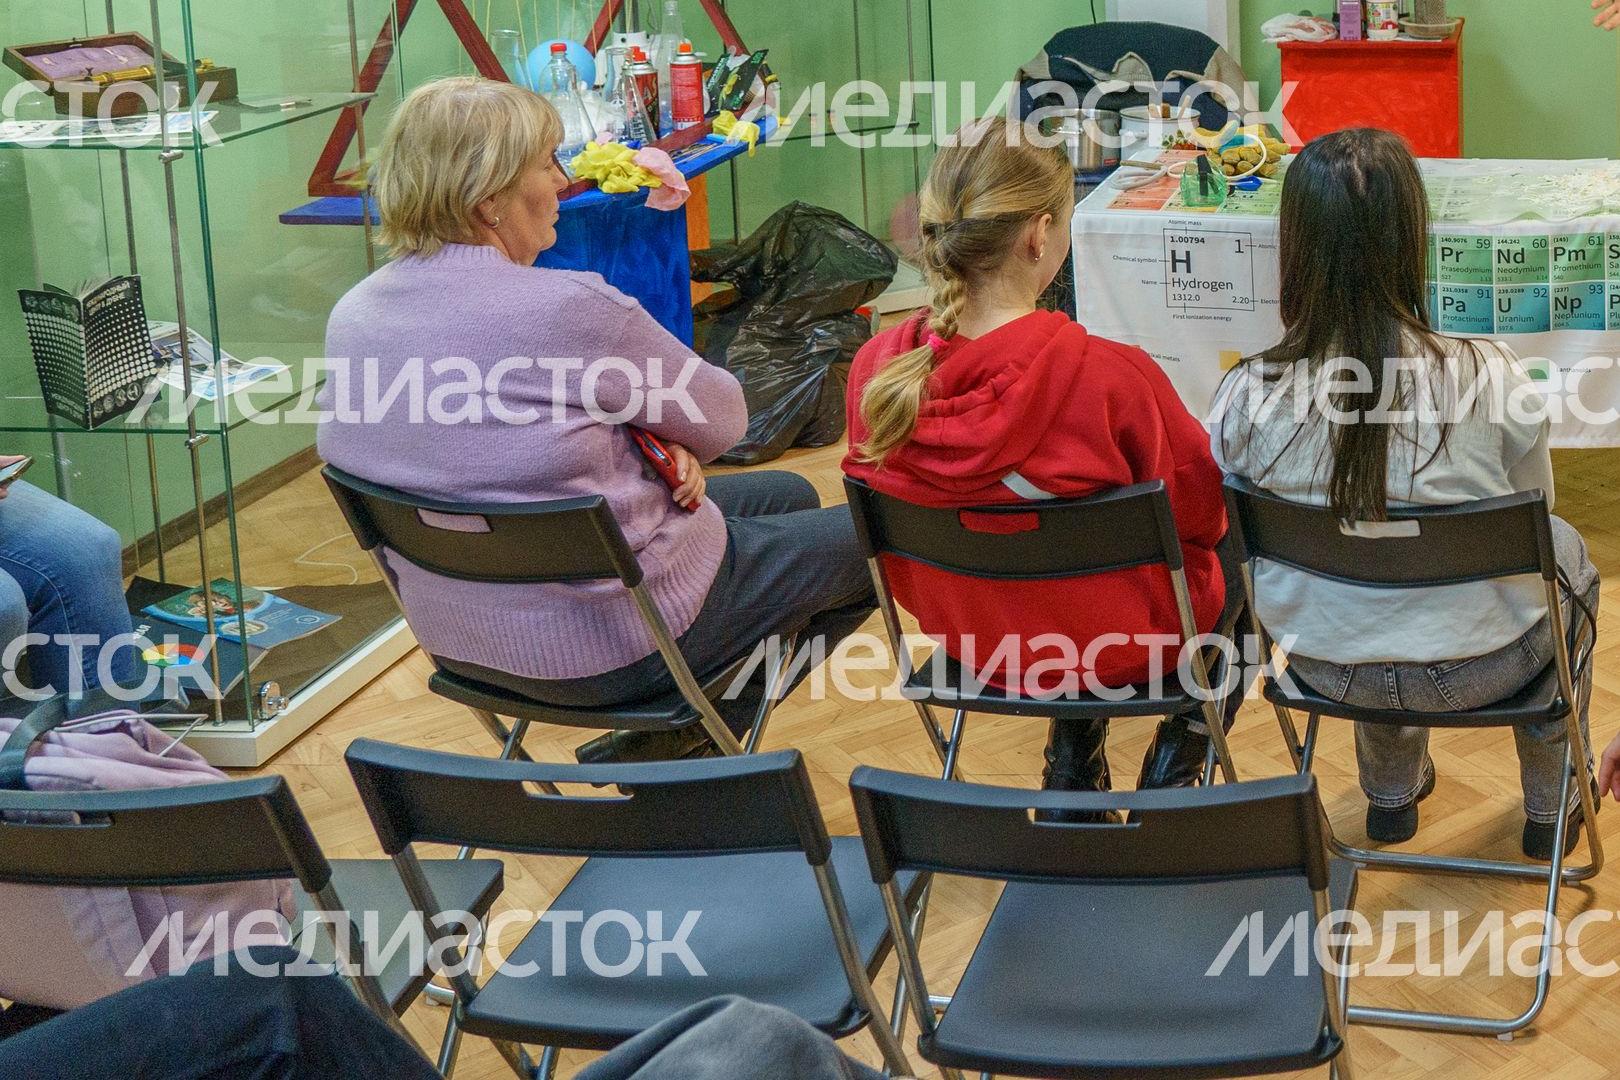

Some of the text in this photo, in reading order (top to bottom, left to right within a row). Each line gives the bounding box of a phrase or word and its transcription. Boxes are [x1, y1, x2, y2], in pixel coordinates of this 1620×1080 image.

[1170, 236, 1205, 244] 1.00794
[1476, 239, 1490, 248] 59
[1533, 239, 1547, 248] 60
[1588, 236, 1603, 246] 61
[1234, 239, 1244, 254] 1
[1113, 255, 1135, 263] Chemical
[1441, 247, 1463, 262] Pr
[1498, 248, 1524, 264] Nd
[1554, 247, 1586, 262] Pm
[1171, 250, 1191, 273] H
[1498, 266, 1545, 274] Neodymium
[1554, 263, 1601, 271] Promethium
[1172, 278, 1233, 292] Hydrogen
[1588, 285, 1603, 294] 93
[1477, 289, 1490, 298] 91
[1533, 288, 1547, 297] 92
[1232, 296, 1249, 304] 2.20
[1443, 297, 1466, 312] Pa
[1555, 296, 1582, 313] Np
[1499, 298, 1511, 312] U
[1443, 315, 1489, 323] Protactinium
[1499, 315, 1534, 323] Uranium
[1555, 312, 1600, 320] Neptunium
